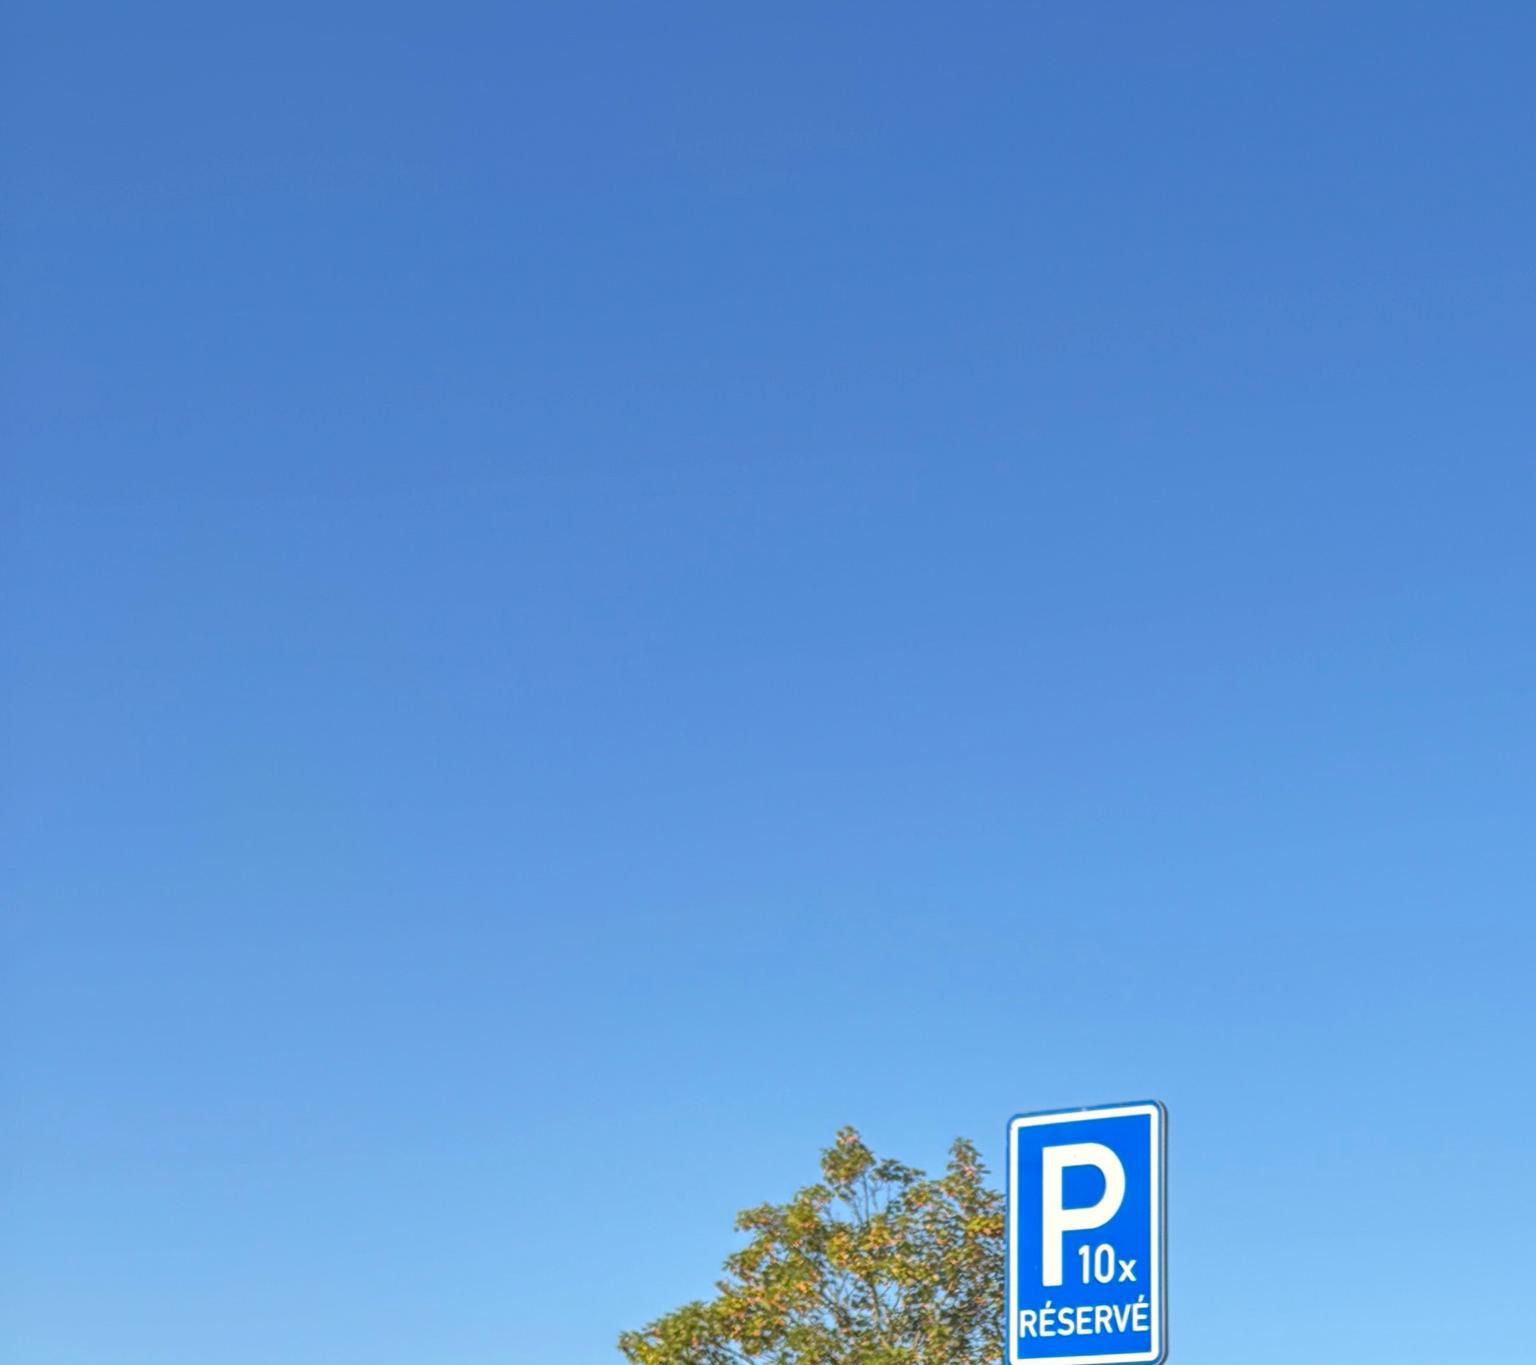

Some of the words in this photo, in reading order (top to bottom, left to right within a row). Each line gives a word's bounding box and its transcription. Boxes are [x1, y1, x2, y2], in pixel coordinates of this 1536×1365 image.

[1042, 1142, 1126, 1287] P
[1078, 1243, 1137, 1284] 10x
[1019, 1294, 1150, 1338] RÉSERVÉ
